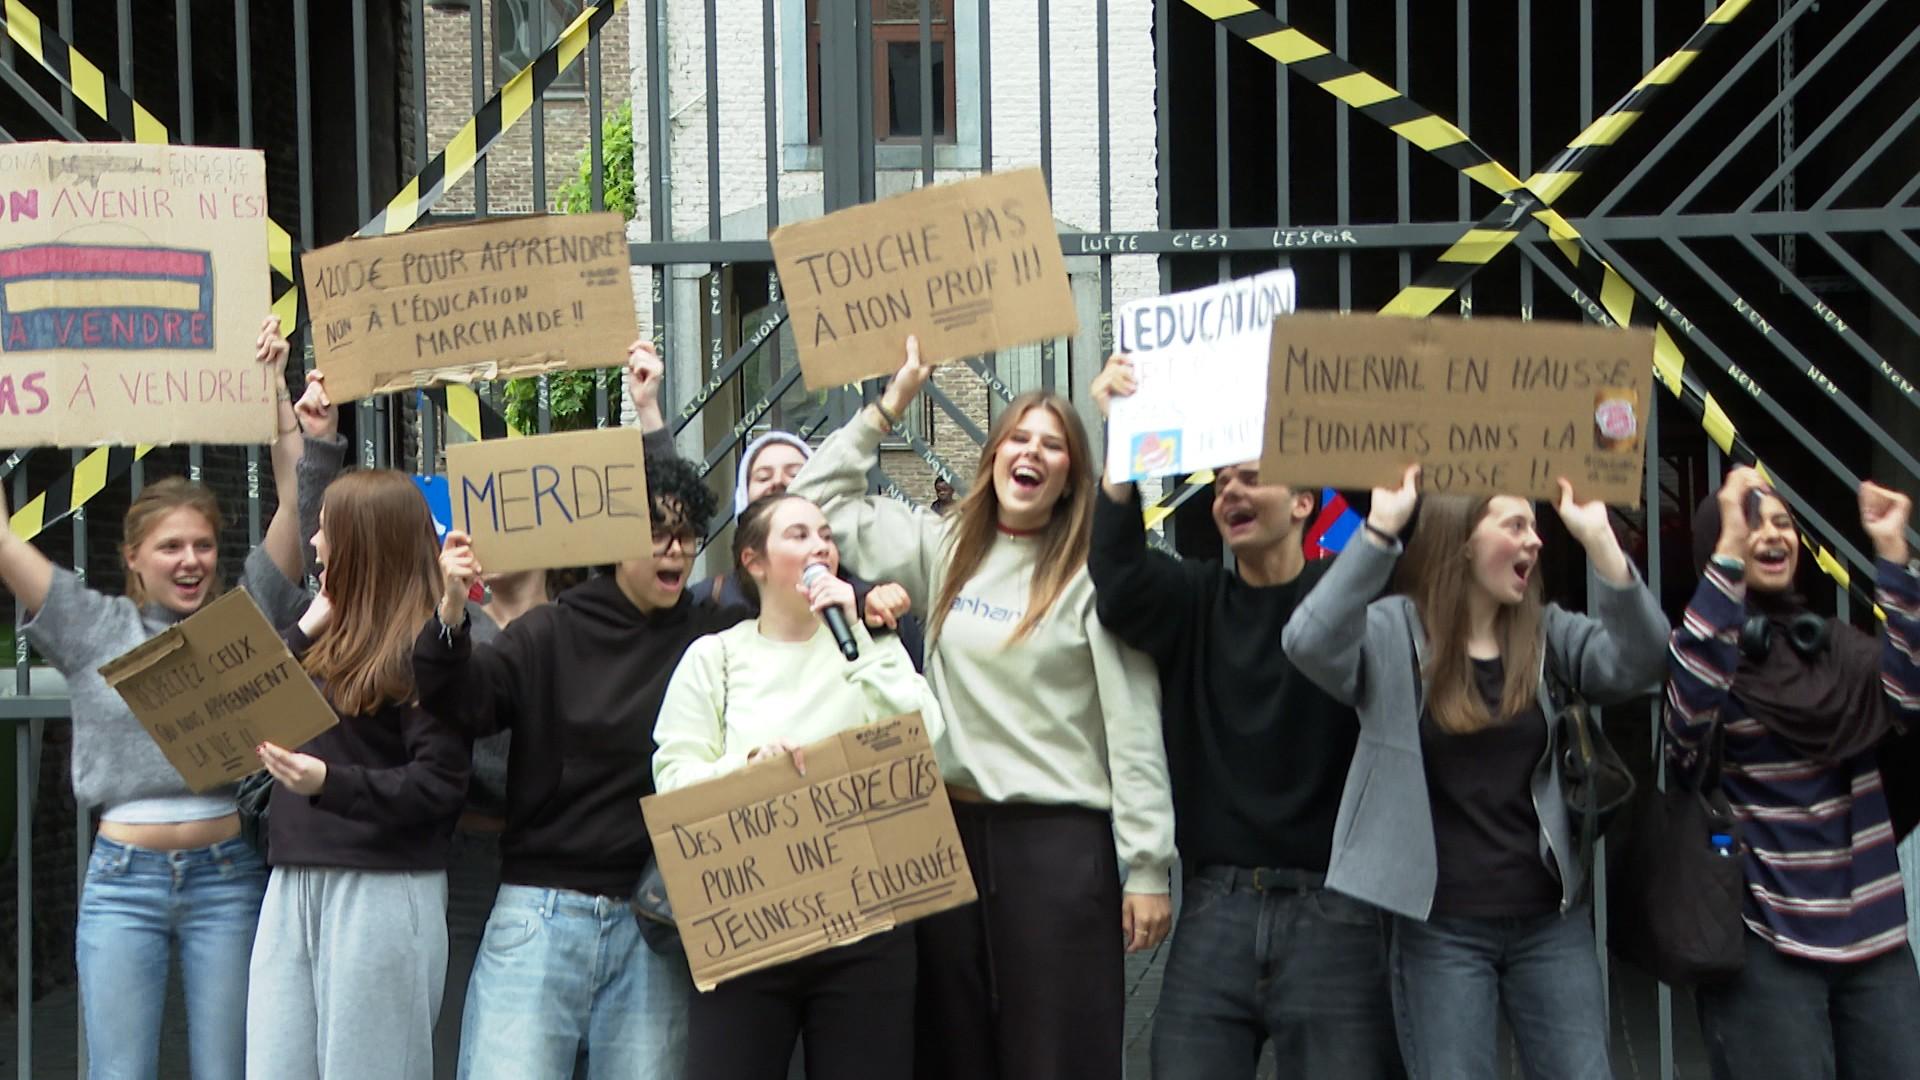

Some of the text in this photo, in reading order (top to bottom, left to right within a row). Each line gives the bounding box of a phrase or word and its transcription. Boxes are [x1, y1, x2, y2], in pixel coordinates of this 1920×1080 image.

[0, 185, 267, 222] N AVENIR N'EST
[795, 199, 1029, 295] TOUCHE PAS
[1080, 230, 1357, 252] LUTTE C'EST L'ESPOIR
[315, 257, 384, 300] 1200€
[402, 250, 468, 285] POUR
[53, 312, 208, 345] VENDRE
[326, 285, 529, 348] NON À L'ÉDUCATION
[815, 305, 837, 348] À
[845, 289, 913, 335] MON
[926, 260, 998, 308] PROF
[415, 308, 564, 357] MARCHANDE
[68, 361, 96, 410] À
[1284, 343, 1426, 396] MINERVAL
[1446, 355, 1489, 393] EN
[1278, 410, 1431, 457] ÉTUDIANTS
[1448, 421, 1518, 453] DANS
[1543, 420, 1575, 450] LA
[462, 464, 643, 535] MERDE
[1417, 462, 1503, 491] FOSSE
[208, 635, 257, 674] CEUX
[186, 739, 209, 768] LA
[208, 730, 237, 760] VIE
[672, 823, 723, 860] DES
[809, 752, 937, 824] RESPECTÉS
[701, 832, 843, 905] POUR UNE
[692, 837, 964, 959] JEUNESSE ÉDUQUÉE
